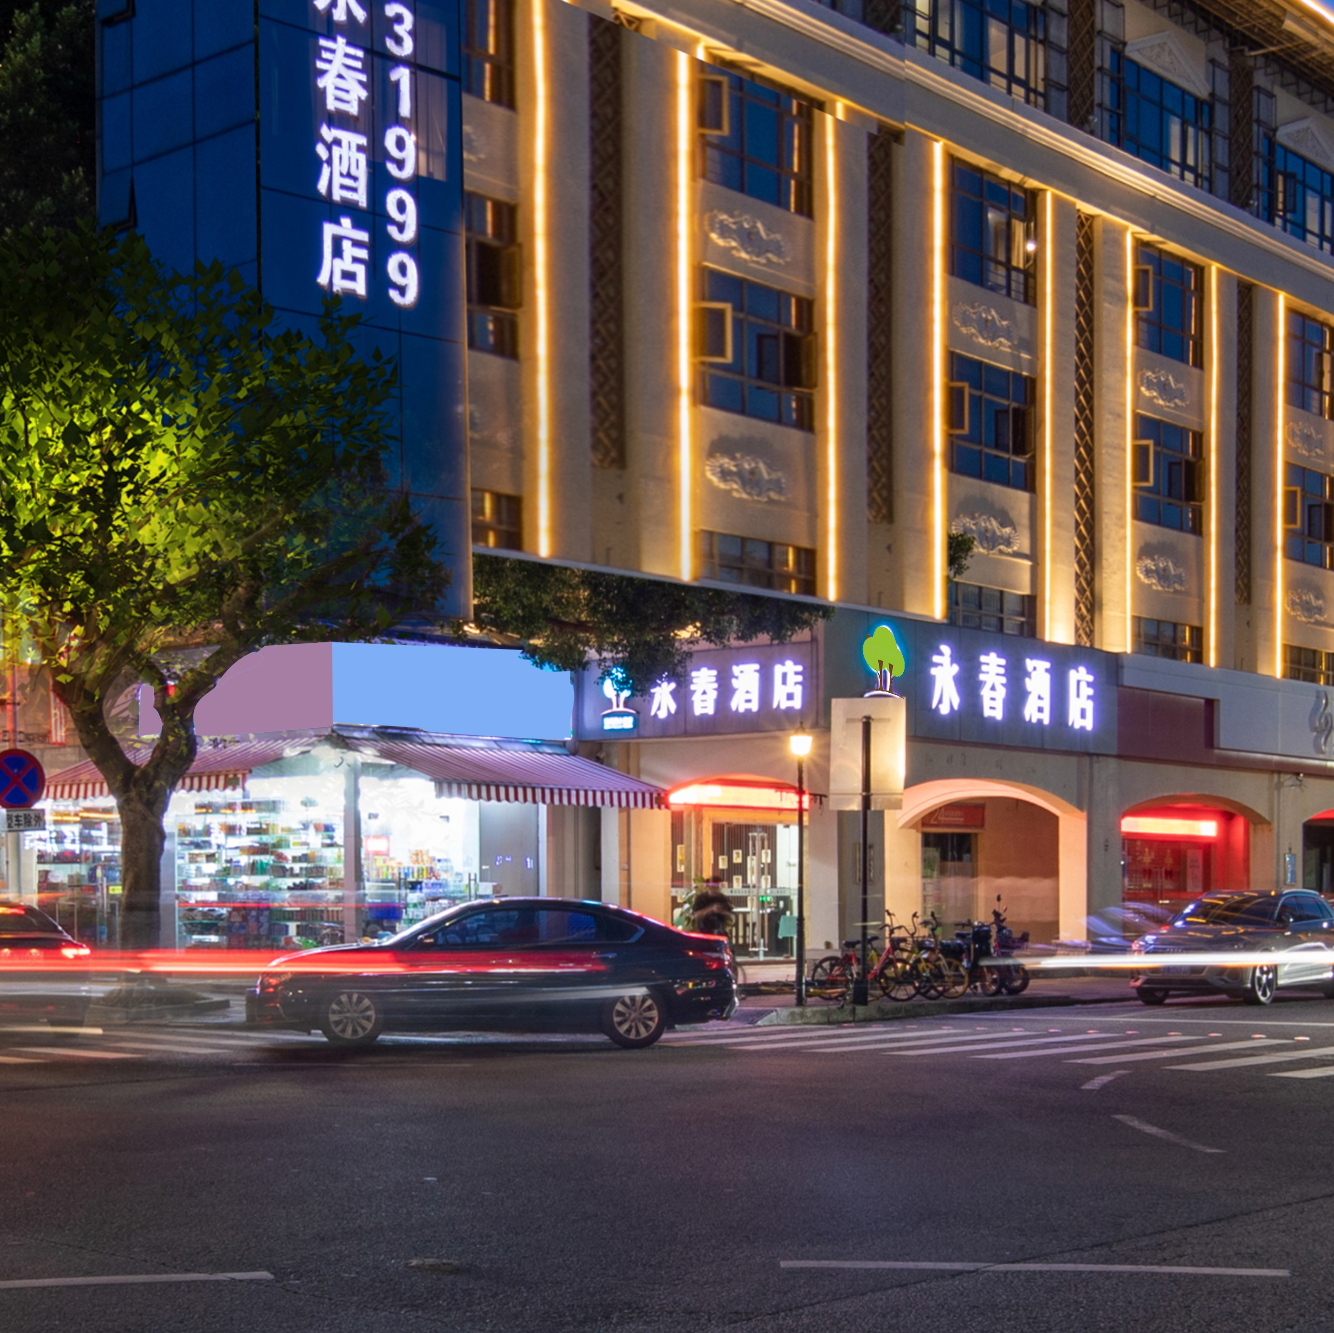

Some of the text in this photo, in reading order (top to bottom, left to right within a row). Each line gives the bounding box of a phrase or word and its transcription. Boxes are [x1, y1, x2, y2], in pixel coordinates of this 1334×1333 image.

[649, 659, 804, 720] 永春酒店
[929, 644, 1095, 732] 永春酒店
